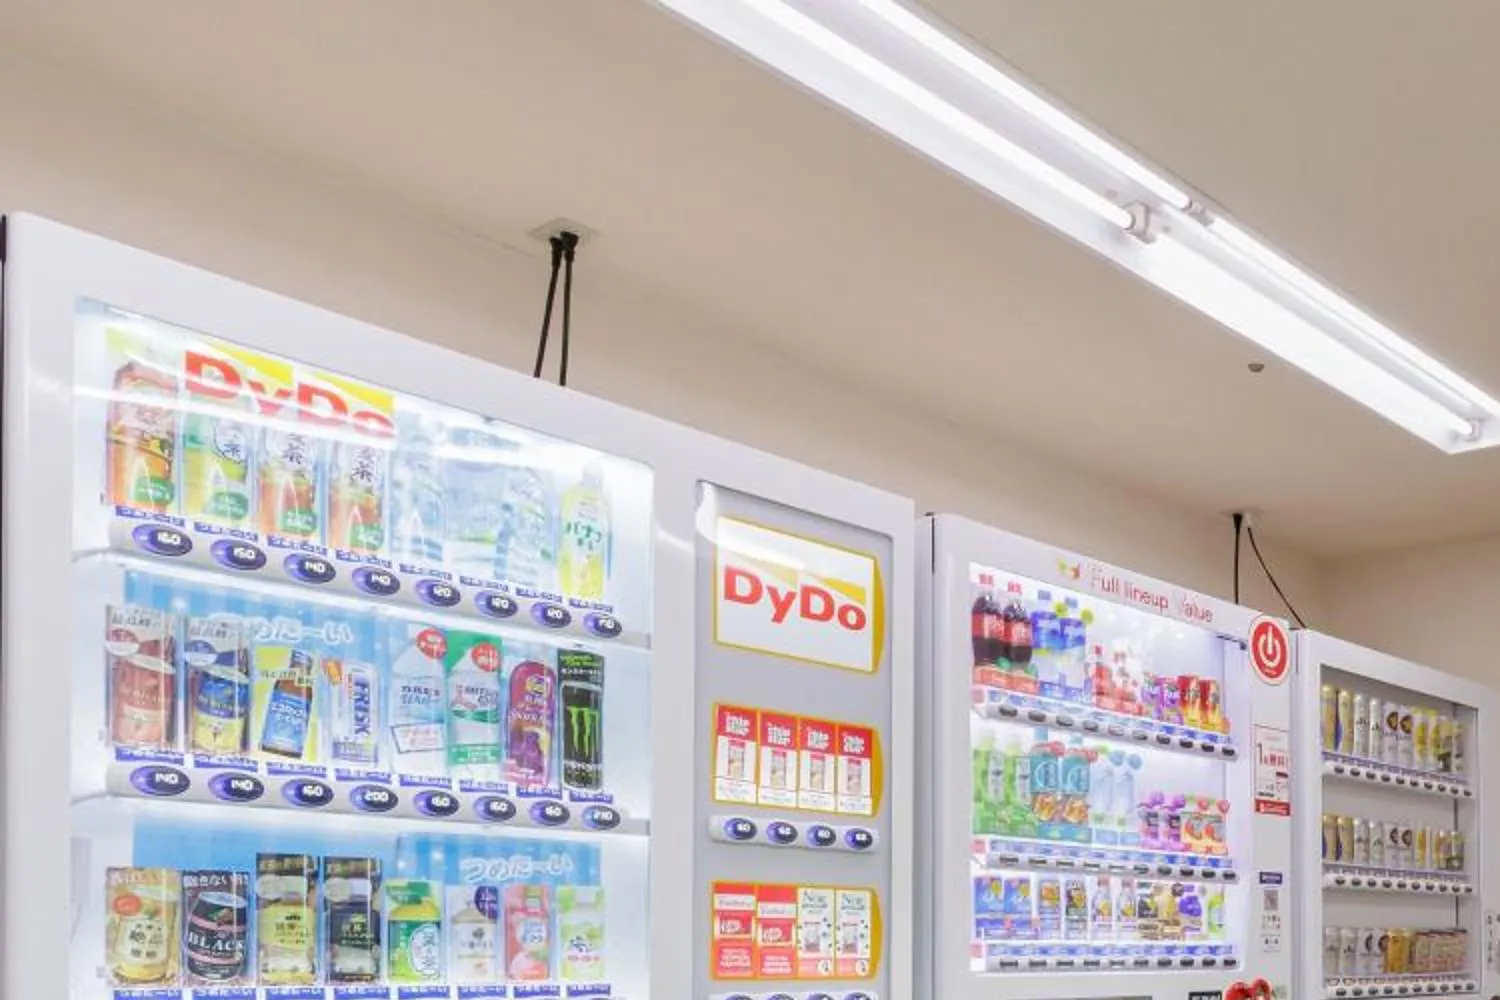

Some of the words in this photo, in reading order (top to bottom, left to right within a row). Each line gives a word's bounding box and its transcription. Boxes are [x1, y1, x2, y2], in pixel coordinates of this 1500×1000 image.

[185, 350, 395, 438] DyDo
[724, 564, 867, 631] DyDo
[1124, 581, 1169, 614] lineup
[354, 675, 371, 735] FRISK
[188, 931, 244, 952] BLACK
